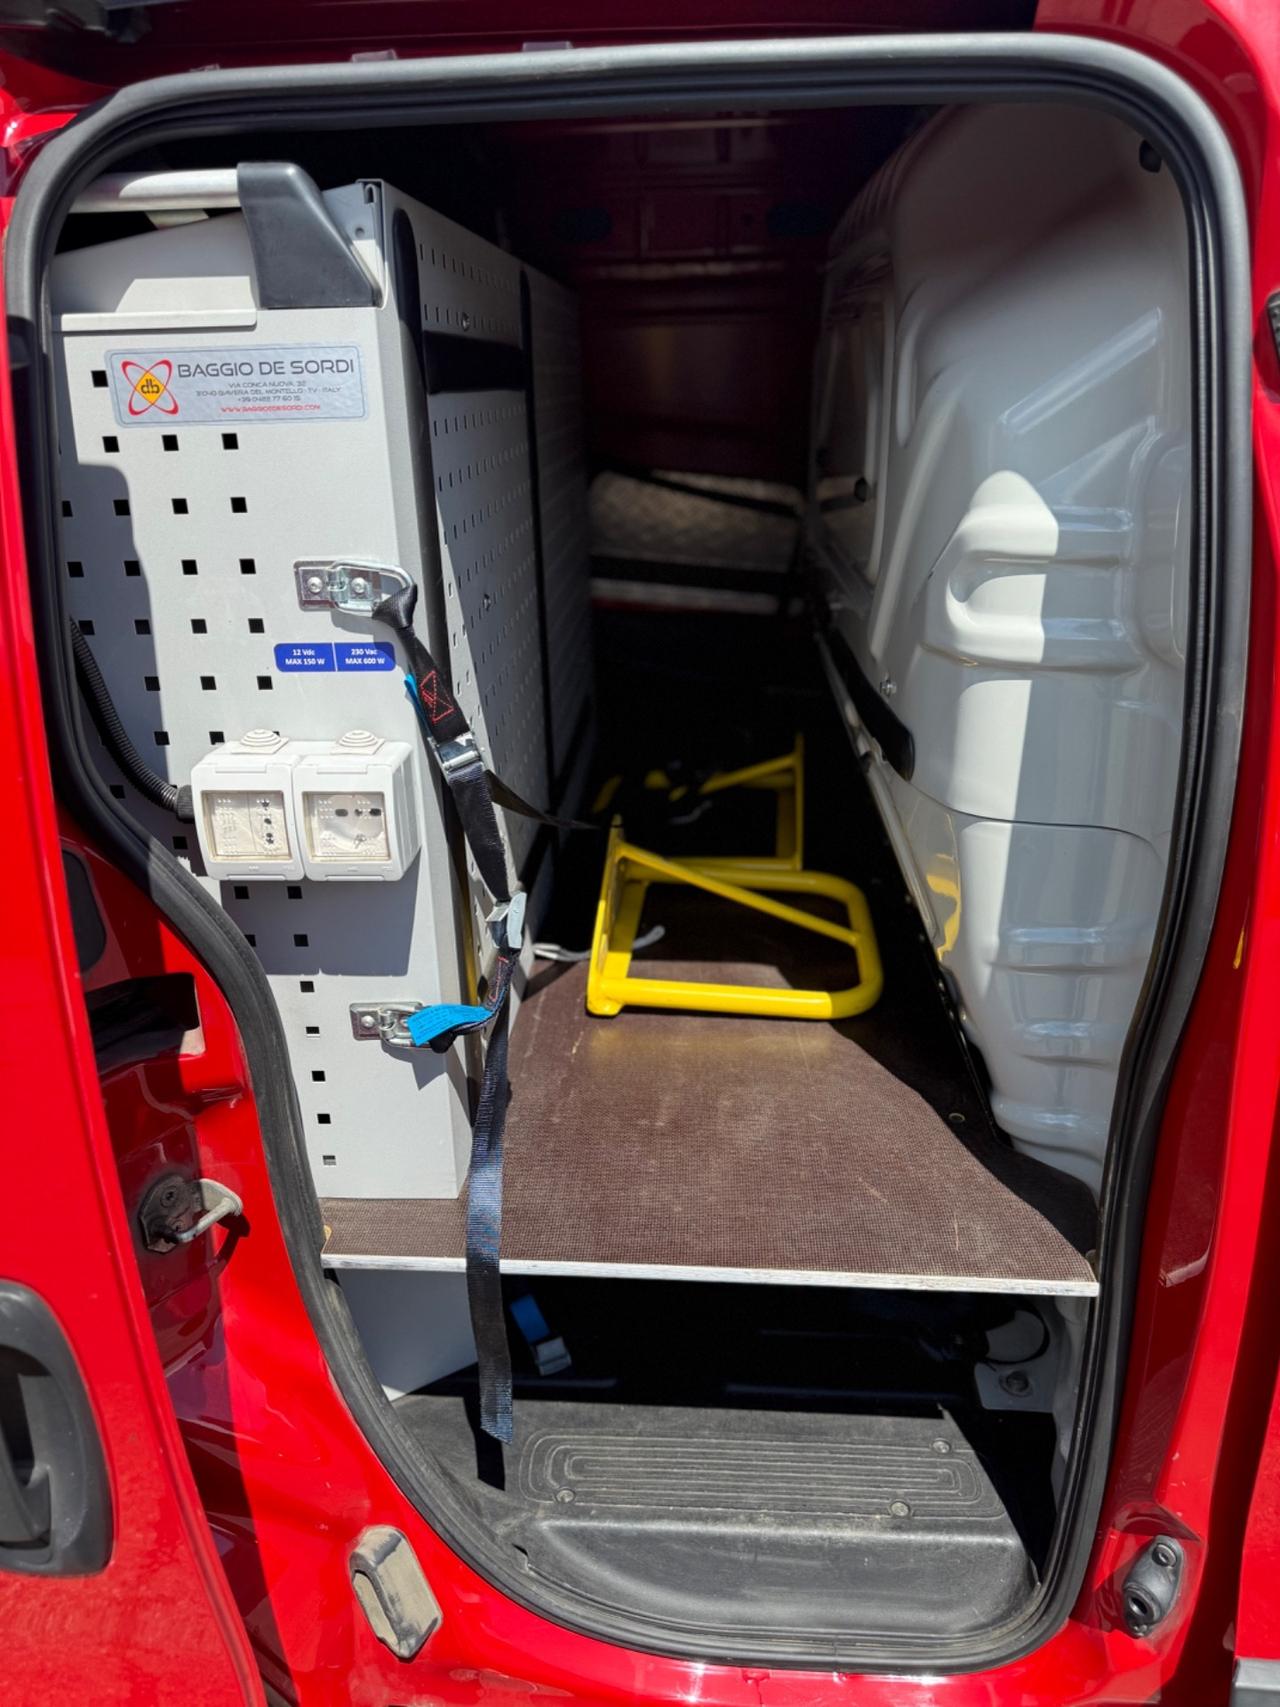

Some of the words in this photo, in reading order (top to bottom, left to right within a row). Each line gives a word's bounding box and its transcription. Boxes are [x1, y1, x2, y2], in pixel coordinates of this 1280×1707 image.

[178, 362, 253, 378] BAGGIO
[259, 361, 285, 375] DE
[290, 359, 354, 374] SORDI
[303, 648, 316, 656] Vdc
[351, 648, 365, 656] 230
[365, 648, 378, 656] Vac
[363, 657, 376, 665] 600
[376, 657, 386, 665] W
